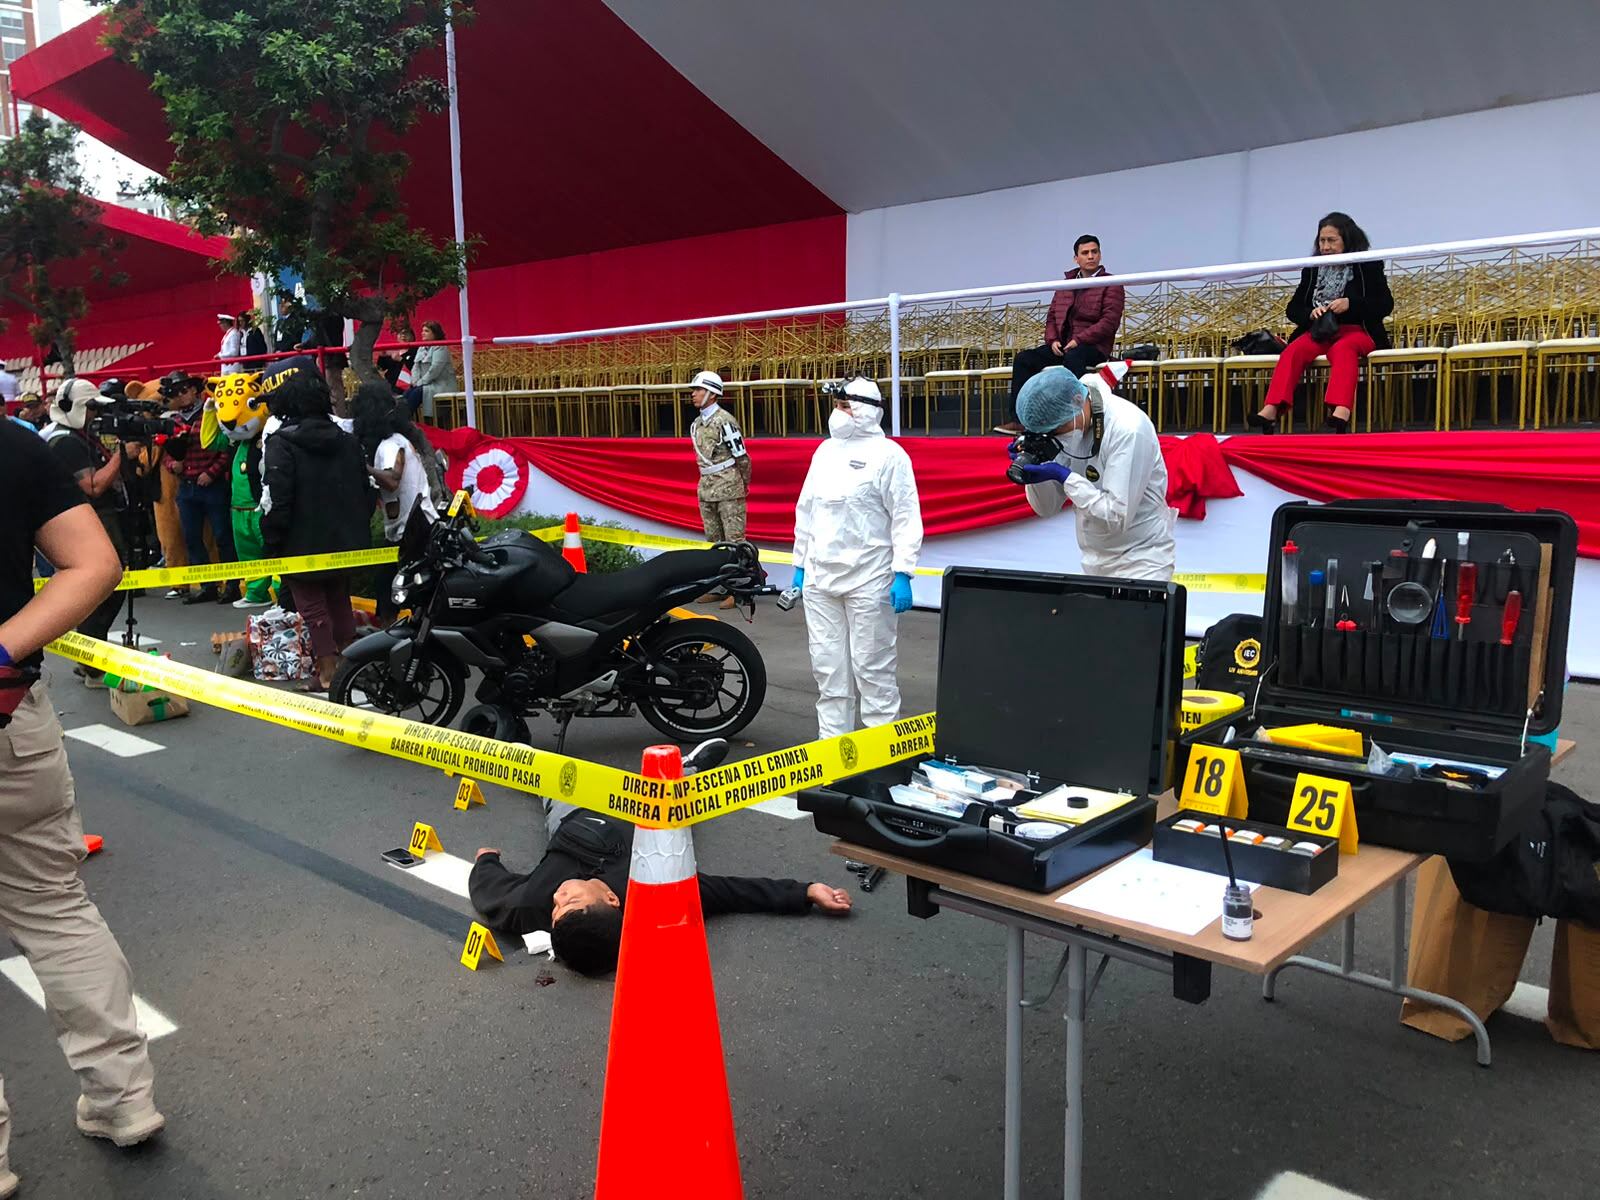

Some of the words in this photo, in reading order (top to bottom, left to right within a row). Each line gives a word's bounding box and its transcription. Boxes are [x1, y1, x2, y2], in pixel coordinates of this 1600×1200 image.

[403, 723, 480, 753] DIRCRI-PNP-ESCENA
[482, 742, 498, 758] DEL
[499, 745, 536, 766] CRIMEN
[890, 735, 930, 758] BARRERA
[390, 737, 424, 757] BARRERA
[426, 746, 461, 769] POLICIAL
[462, 755, 509, 780] PROHIBIDO
[511, 768, 541, 789] PASAR
[743, 759, 765, 778] DEL
[766, 748, 809, 772] CRIMEN
[1193, 756, 1226, 797] 18
[458, 782, 471, 802] 03
[608, 794, 661, 822] BARRERA
[725, 774, 787, 806] PROHIBIDO
[790, 763, 823, 786] PASAR
[1293, 785, 1339, 831] 25
[412, 828, 427, 850] 02
[467, 930, 482, 958] 01
